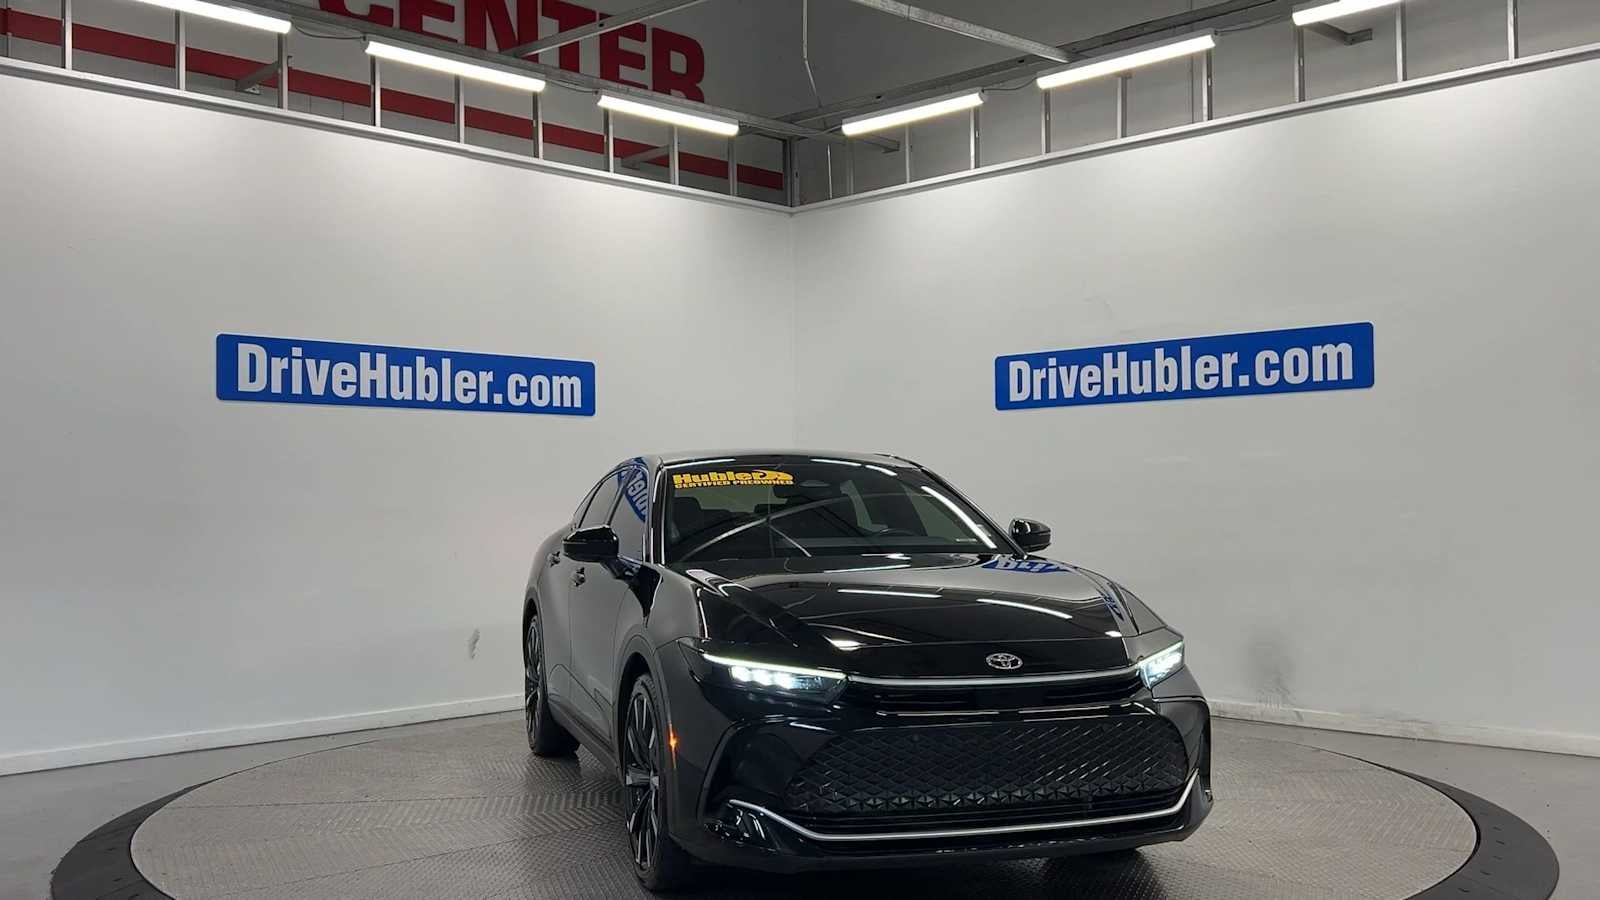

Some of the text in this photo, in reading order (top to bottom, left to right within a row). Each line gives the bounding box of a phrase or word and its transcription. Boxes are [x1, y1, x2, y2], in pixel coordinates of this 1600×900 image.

[237, 342, 582, 408] DriveHubler.com
[1008, 342, 1353, 402] DriveHubler.com
[673, 469, 794, 485] Hubler
[674, 480, 731, 489] CERTIFIED
